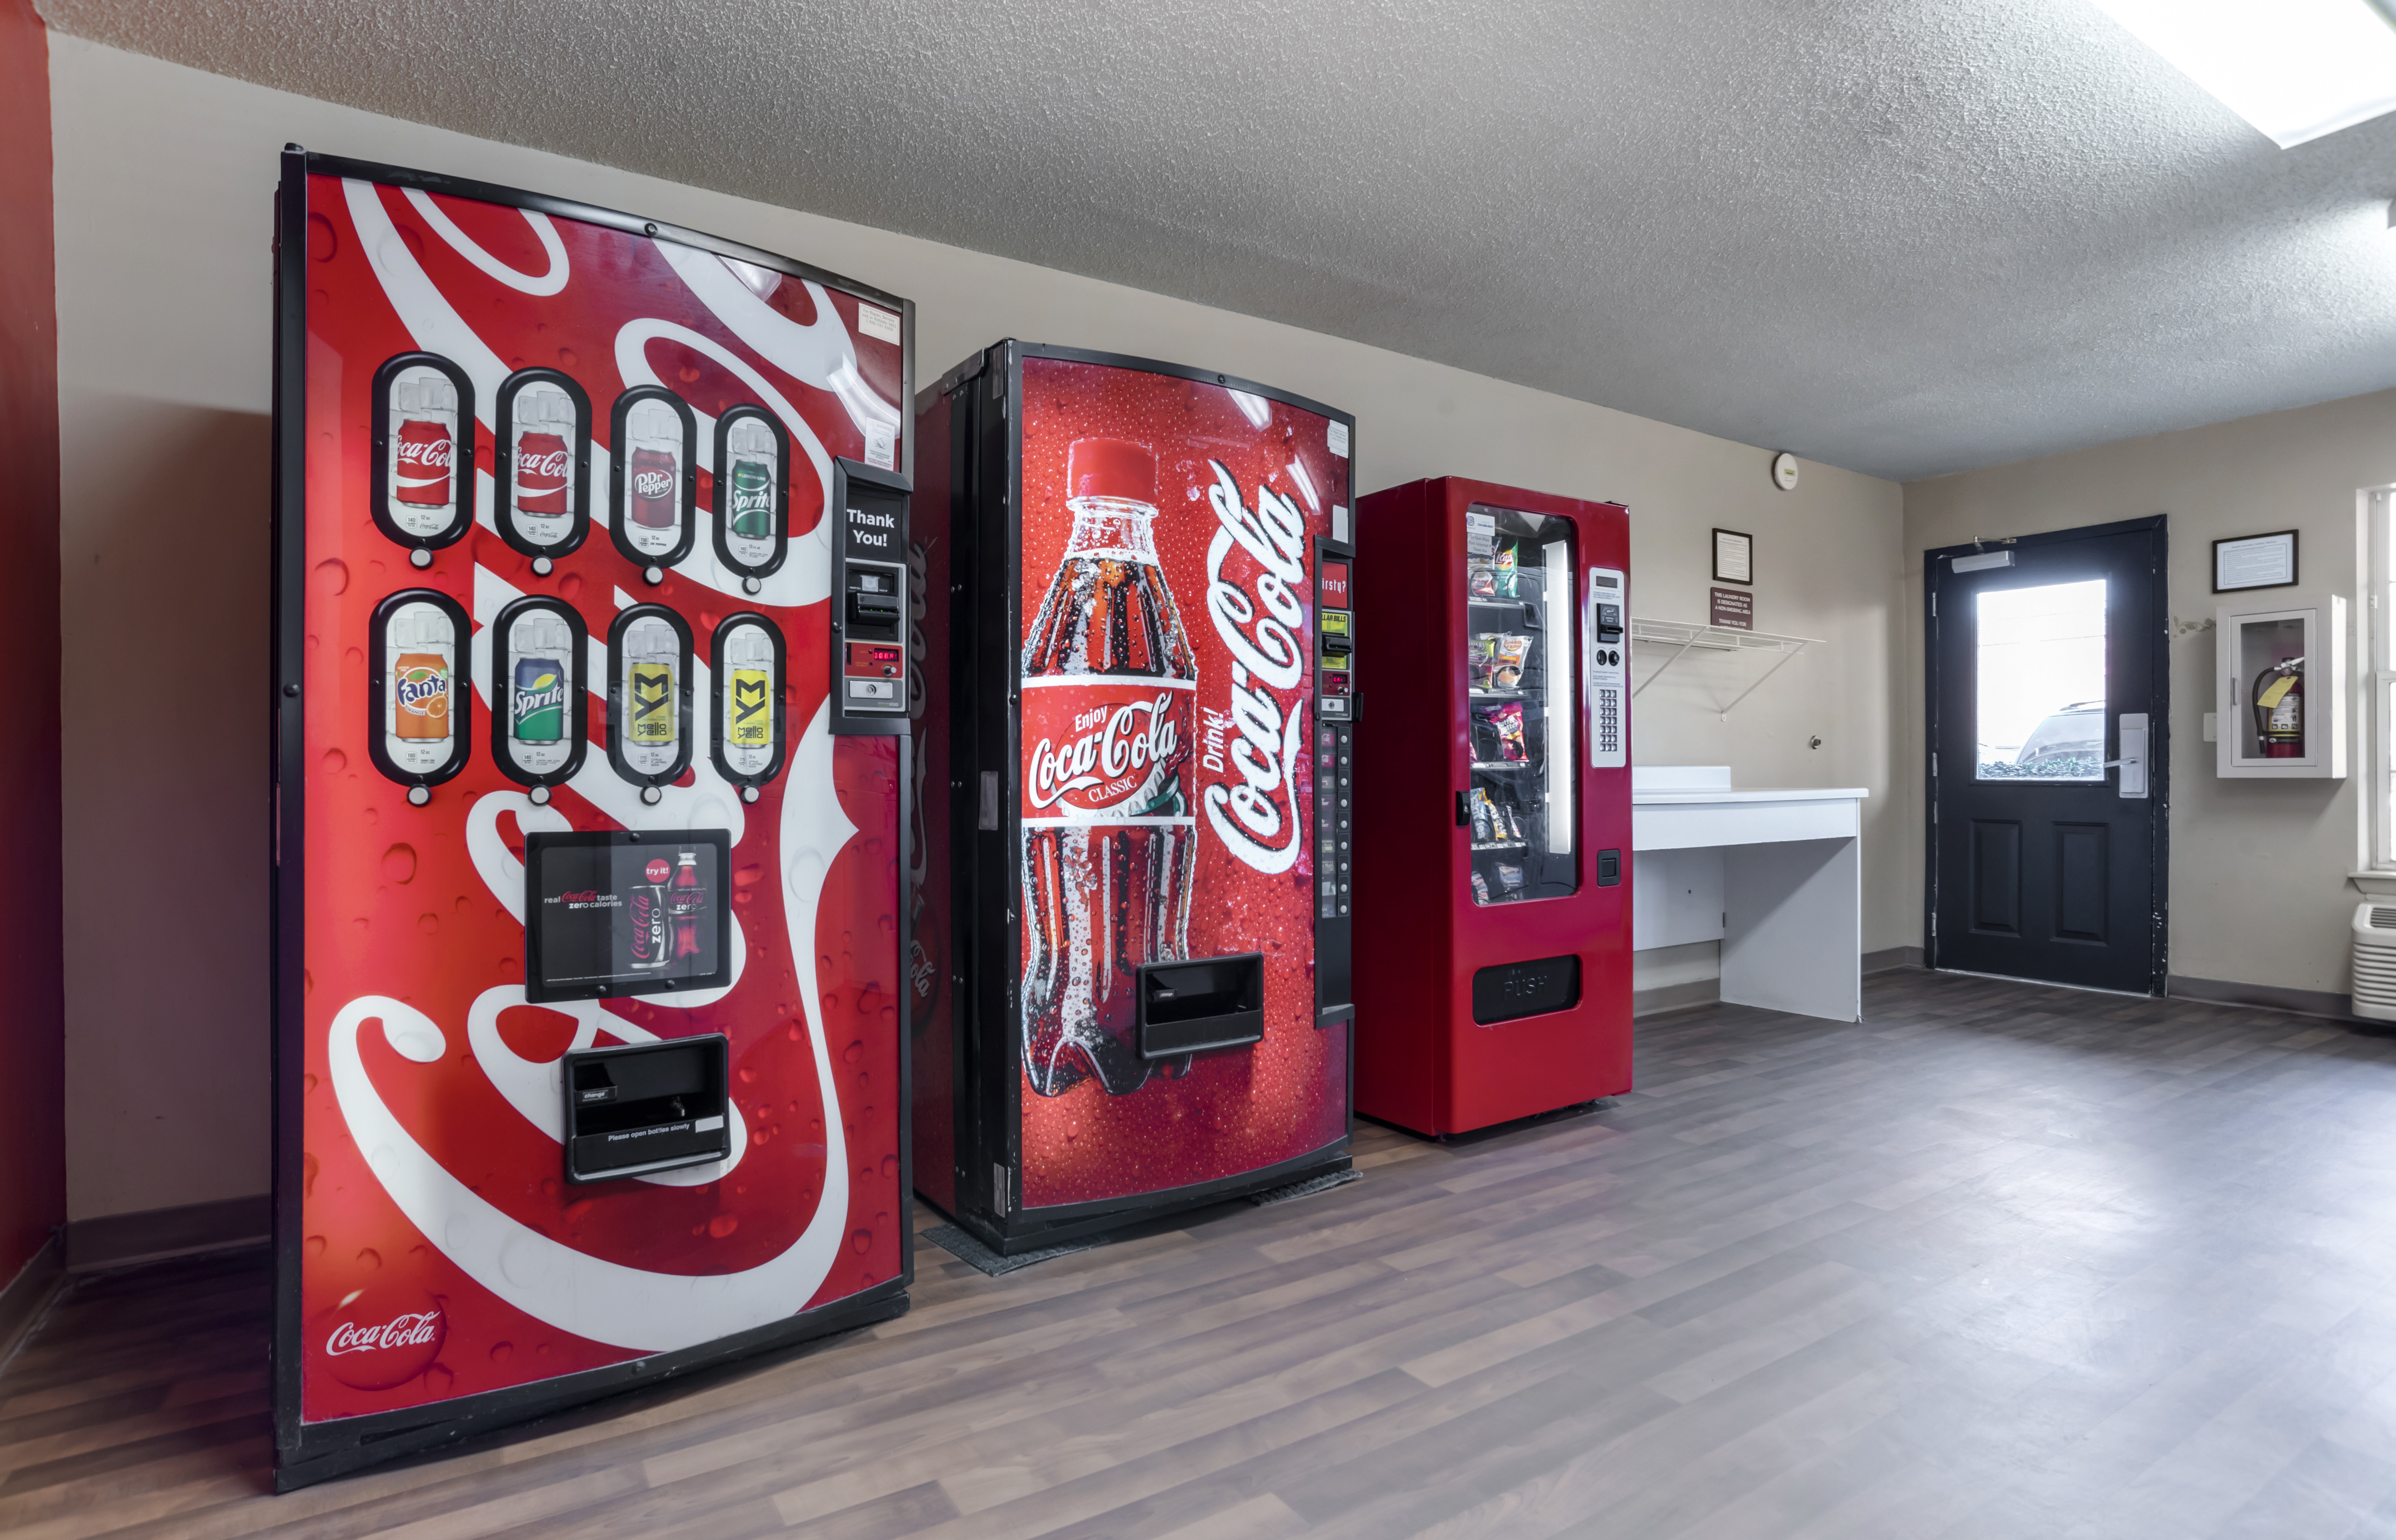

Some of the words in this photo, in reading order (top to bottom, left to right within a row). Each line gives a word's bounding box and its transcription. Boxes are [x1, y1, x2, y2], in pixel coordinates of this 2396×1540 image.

[638, 472, 671, 495] Pepper
[648, 472, 663, 483] Dr
[846, 509, 895, 528] Thank
[853, 530, 888, 547] You!
[1204, 458, 1306, 875] Coca-Cola
[397, 675, 446, 706] Fanta
[515, 685, 564, 717] Sprite
[405, 706, 425, 715] ORANGE
[1075, 705, 1108, 732] Enjoy
[1496, 716, 1515, 729] Nutter
[1500, 722, 1518, 736] Butter
[1029, 690, 1178, 810] Coca-Cola
[1204, 706, 1224, 773] Drink!
[1088, 775, 1137, 802] CLASSIC
[646, 867, 659, 876] try
[562, 890, 597, 903] Coca-Cola
[670, 891, 704, 904] Coca-Cola
[629, 895, 650, 959] Coca-Cola
[652, 908, 661, 944] zero
[631, 1130, 646, 1138] open
[648, 1126, 669, 1135] bottles
[670, 1123, 690, 1132] slowly
[326, 1311, 441, 1356] Coca-Cola
